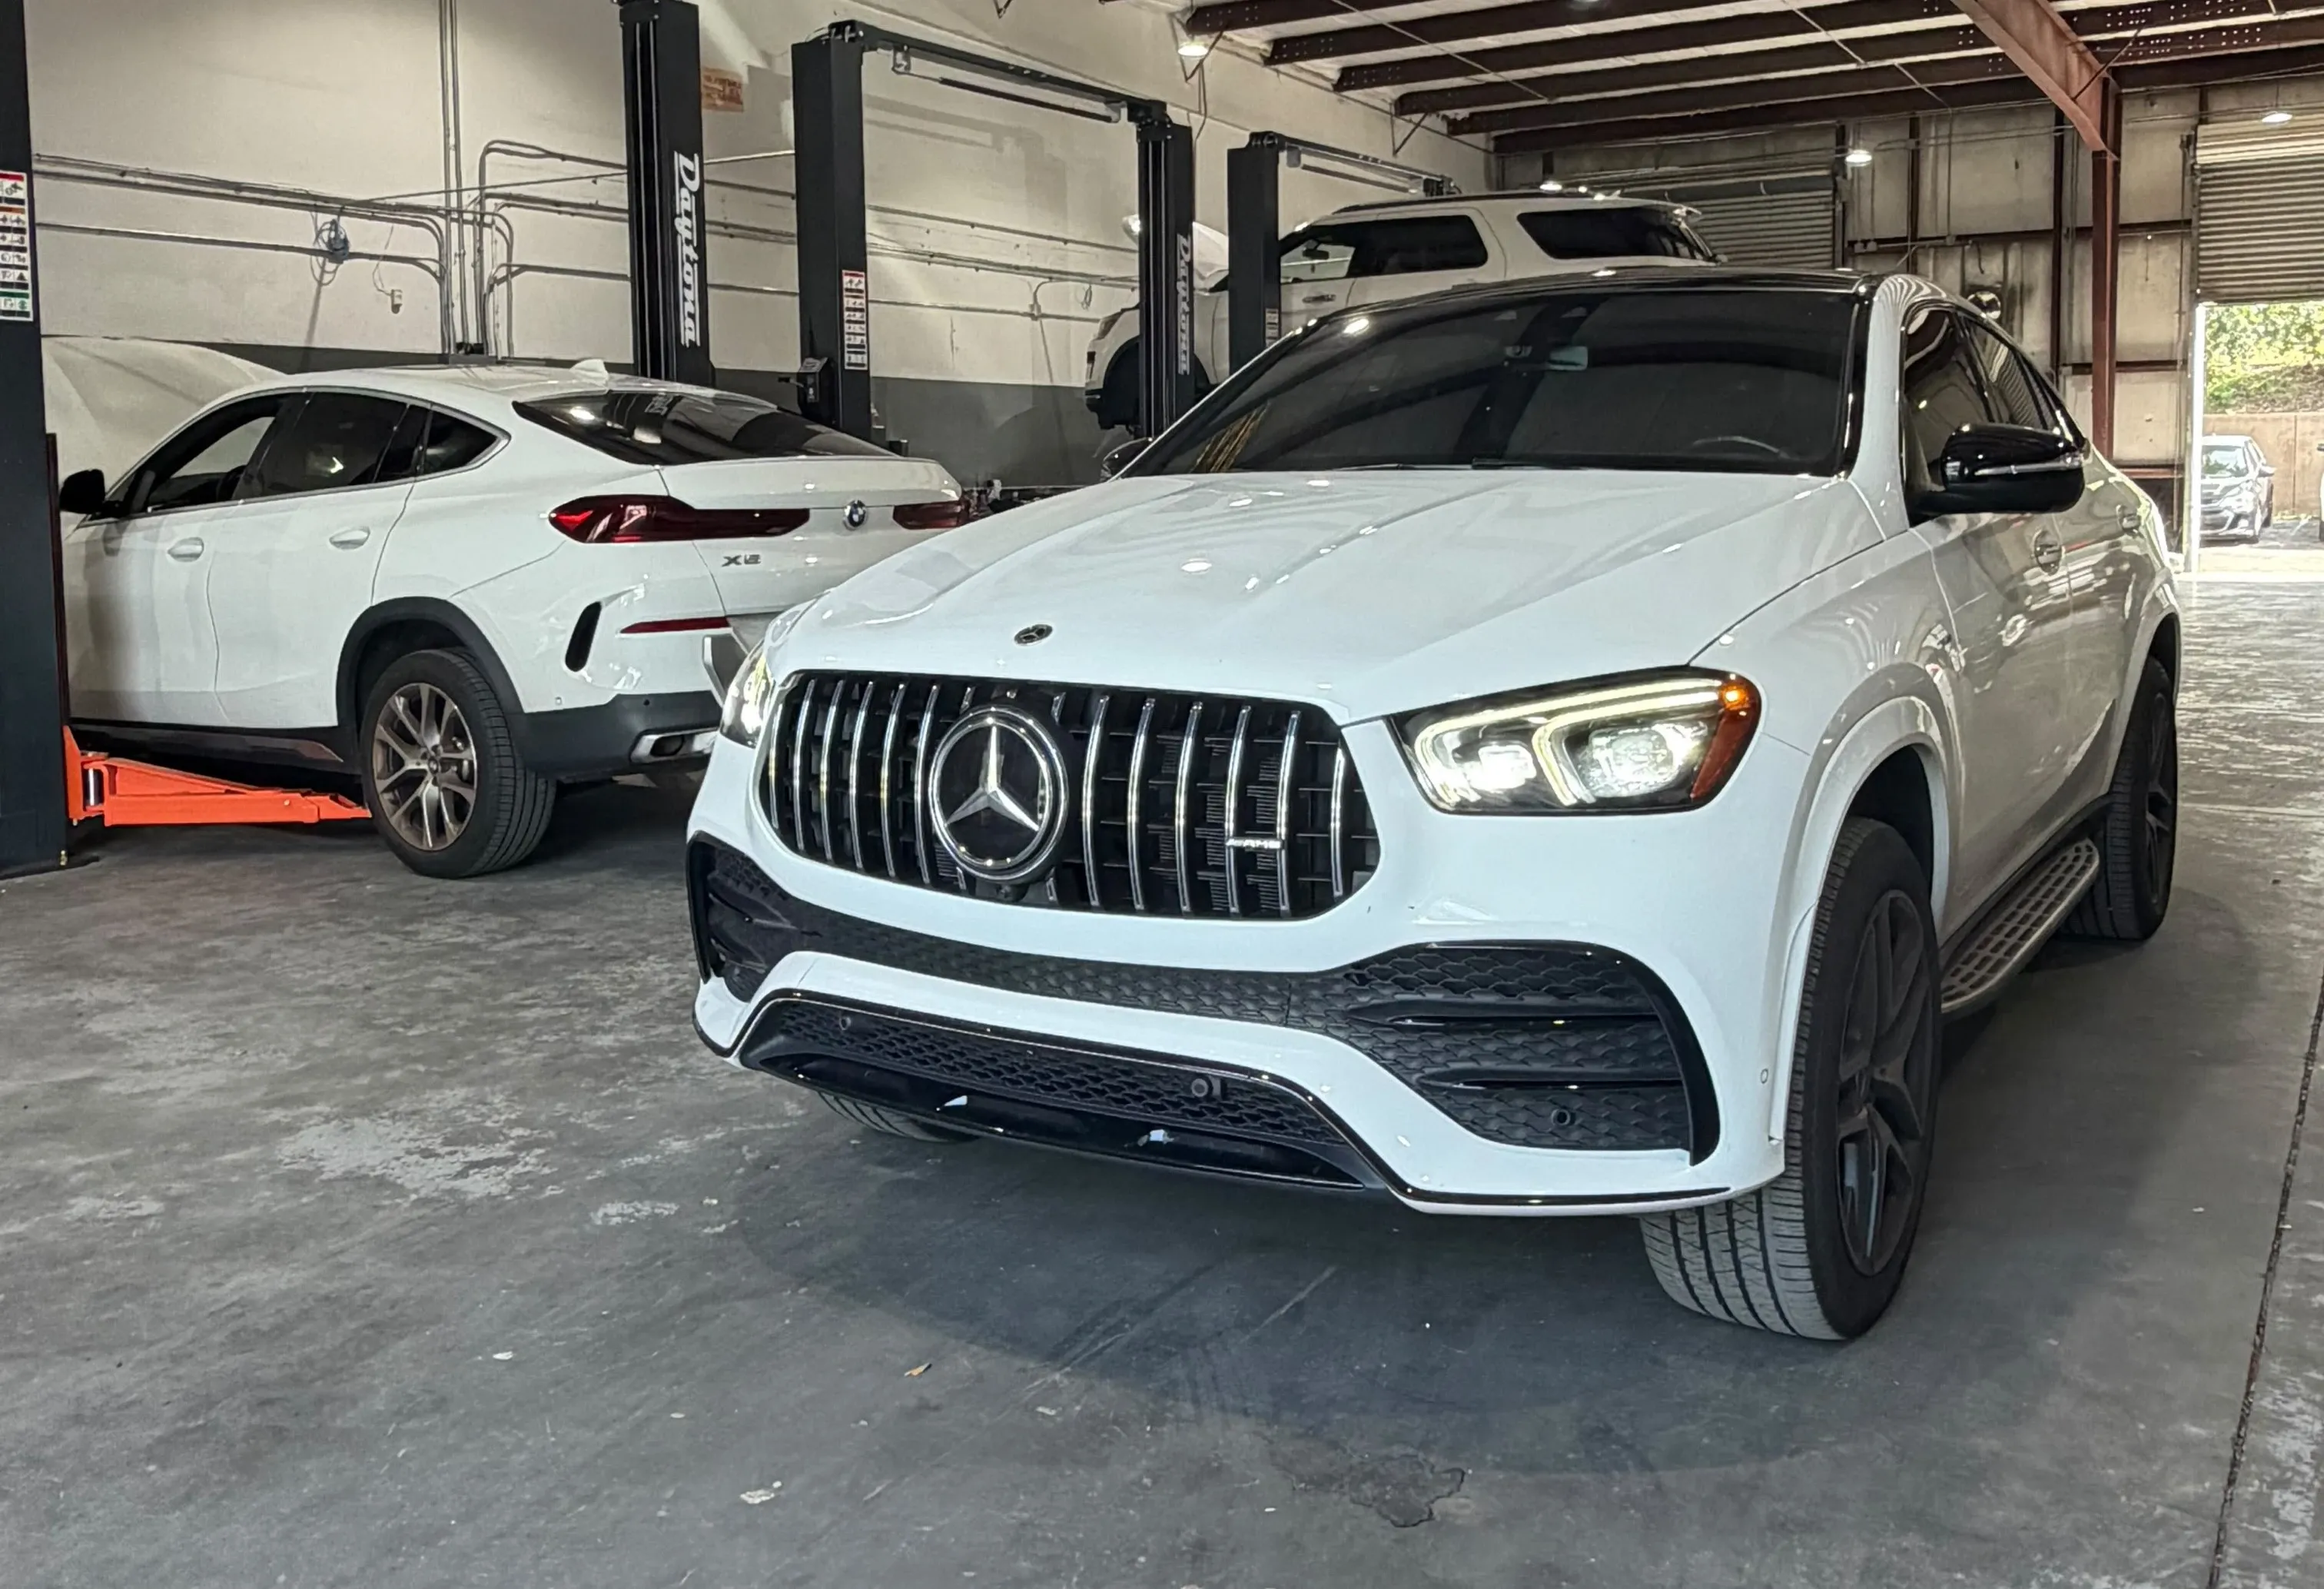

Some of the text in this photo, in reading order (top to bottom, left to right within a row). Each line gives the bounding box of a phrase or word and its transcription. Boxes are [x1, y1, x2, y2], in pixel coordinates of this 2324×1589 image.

[674, 150, 701, 348] Daytona
[1177, 233, 1191, 375] Daytona
[722, 553, 762, 567] X6
